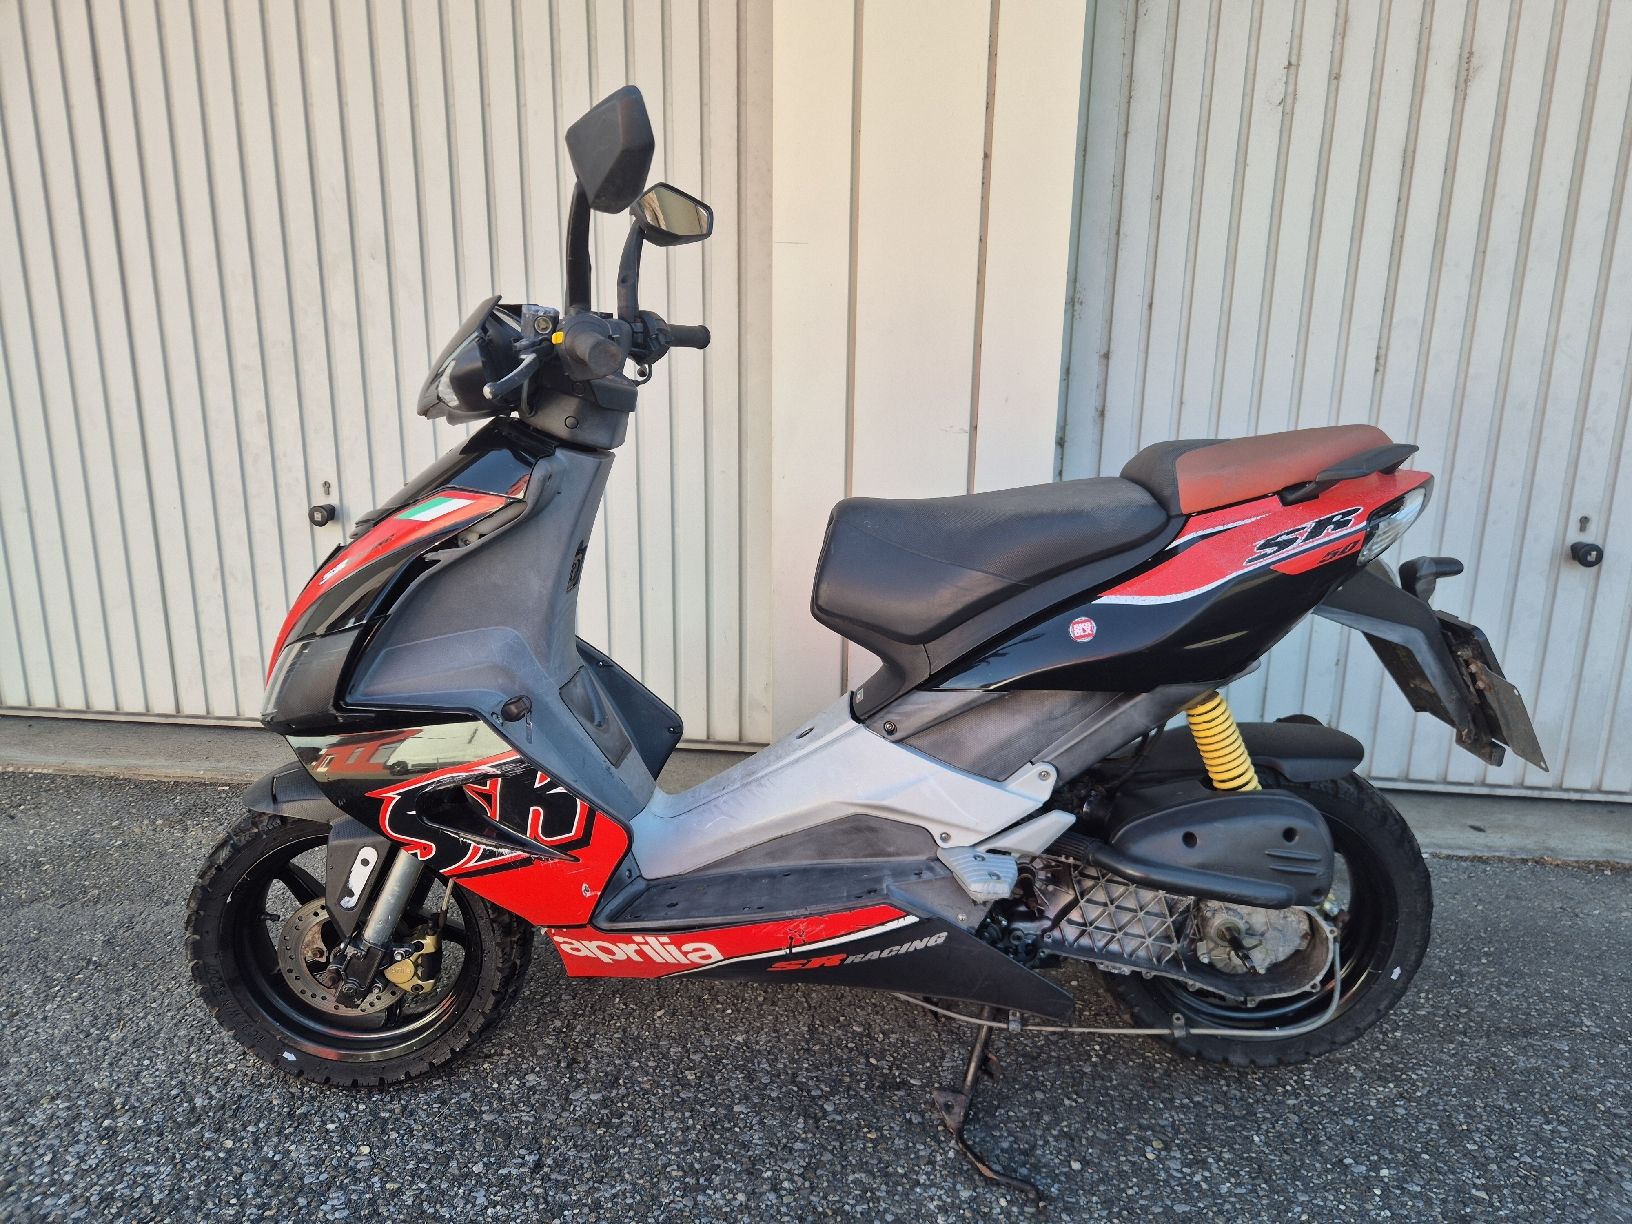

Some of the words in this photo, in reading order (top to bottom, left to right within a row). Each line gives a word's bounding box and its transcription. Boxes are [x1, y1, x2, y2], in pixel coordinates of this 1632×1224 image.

[1244, 506, 1363, 566] SR
[1318, 540, 1361, 564] 50
[553, 935, 724, 964] aprilia
[767, 954, 846, 971] SR
[846, 931, 949, 964] RACING
